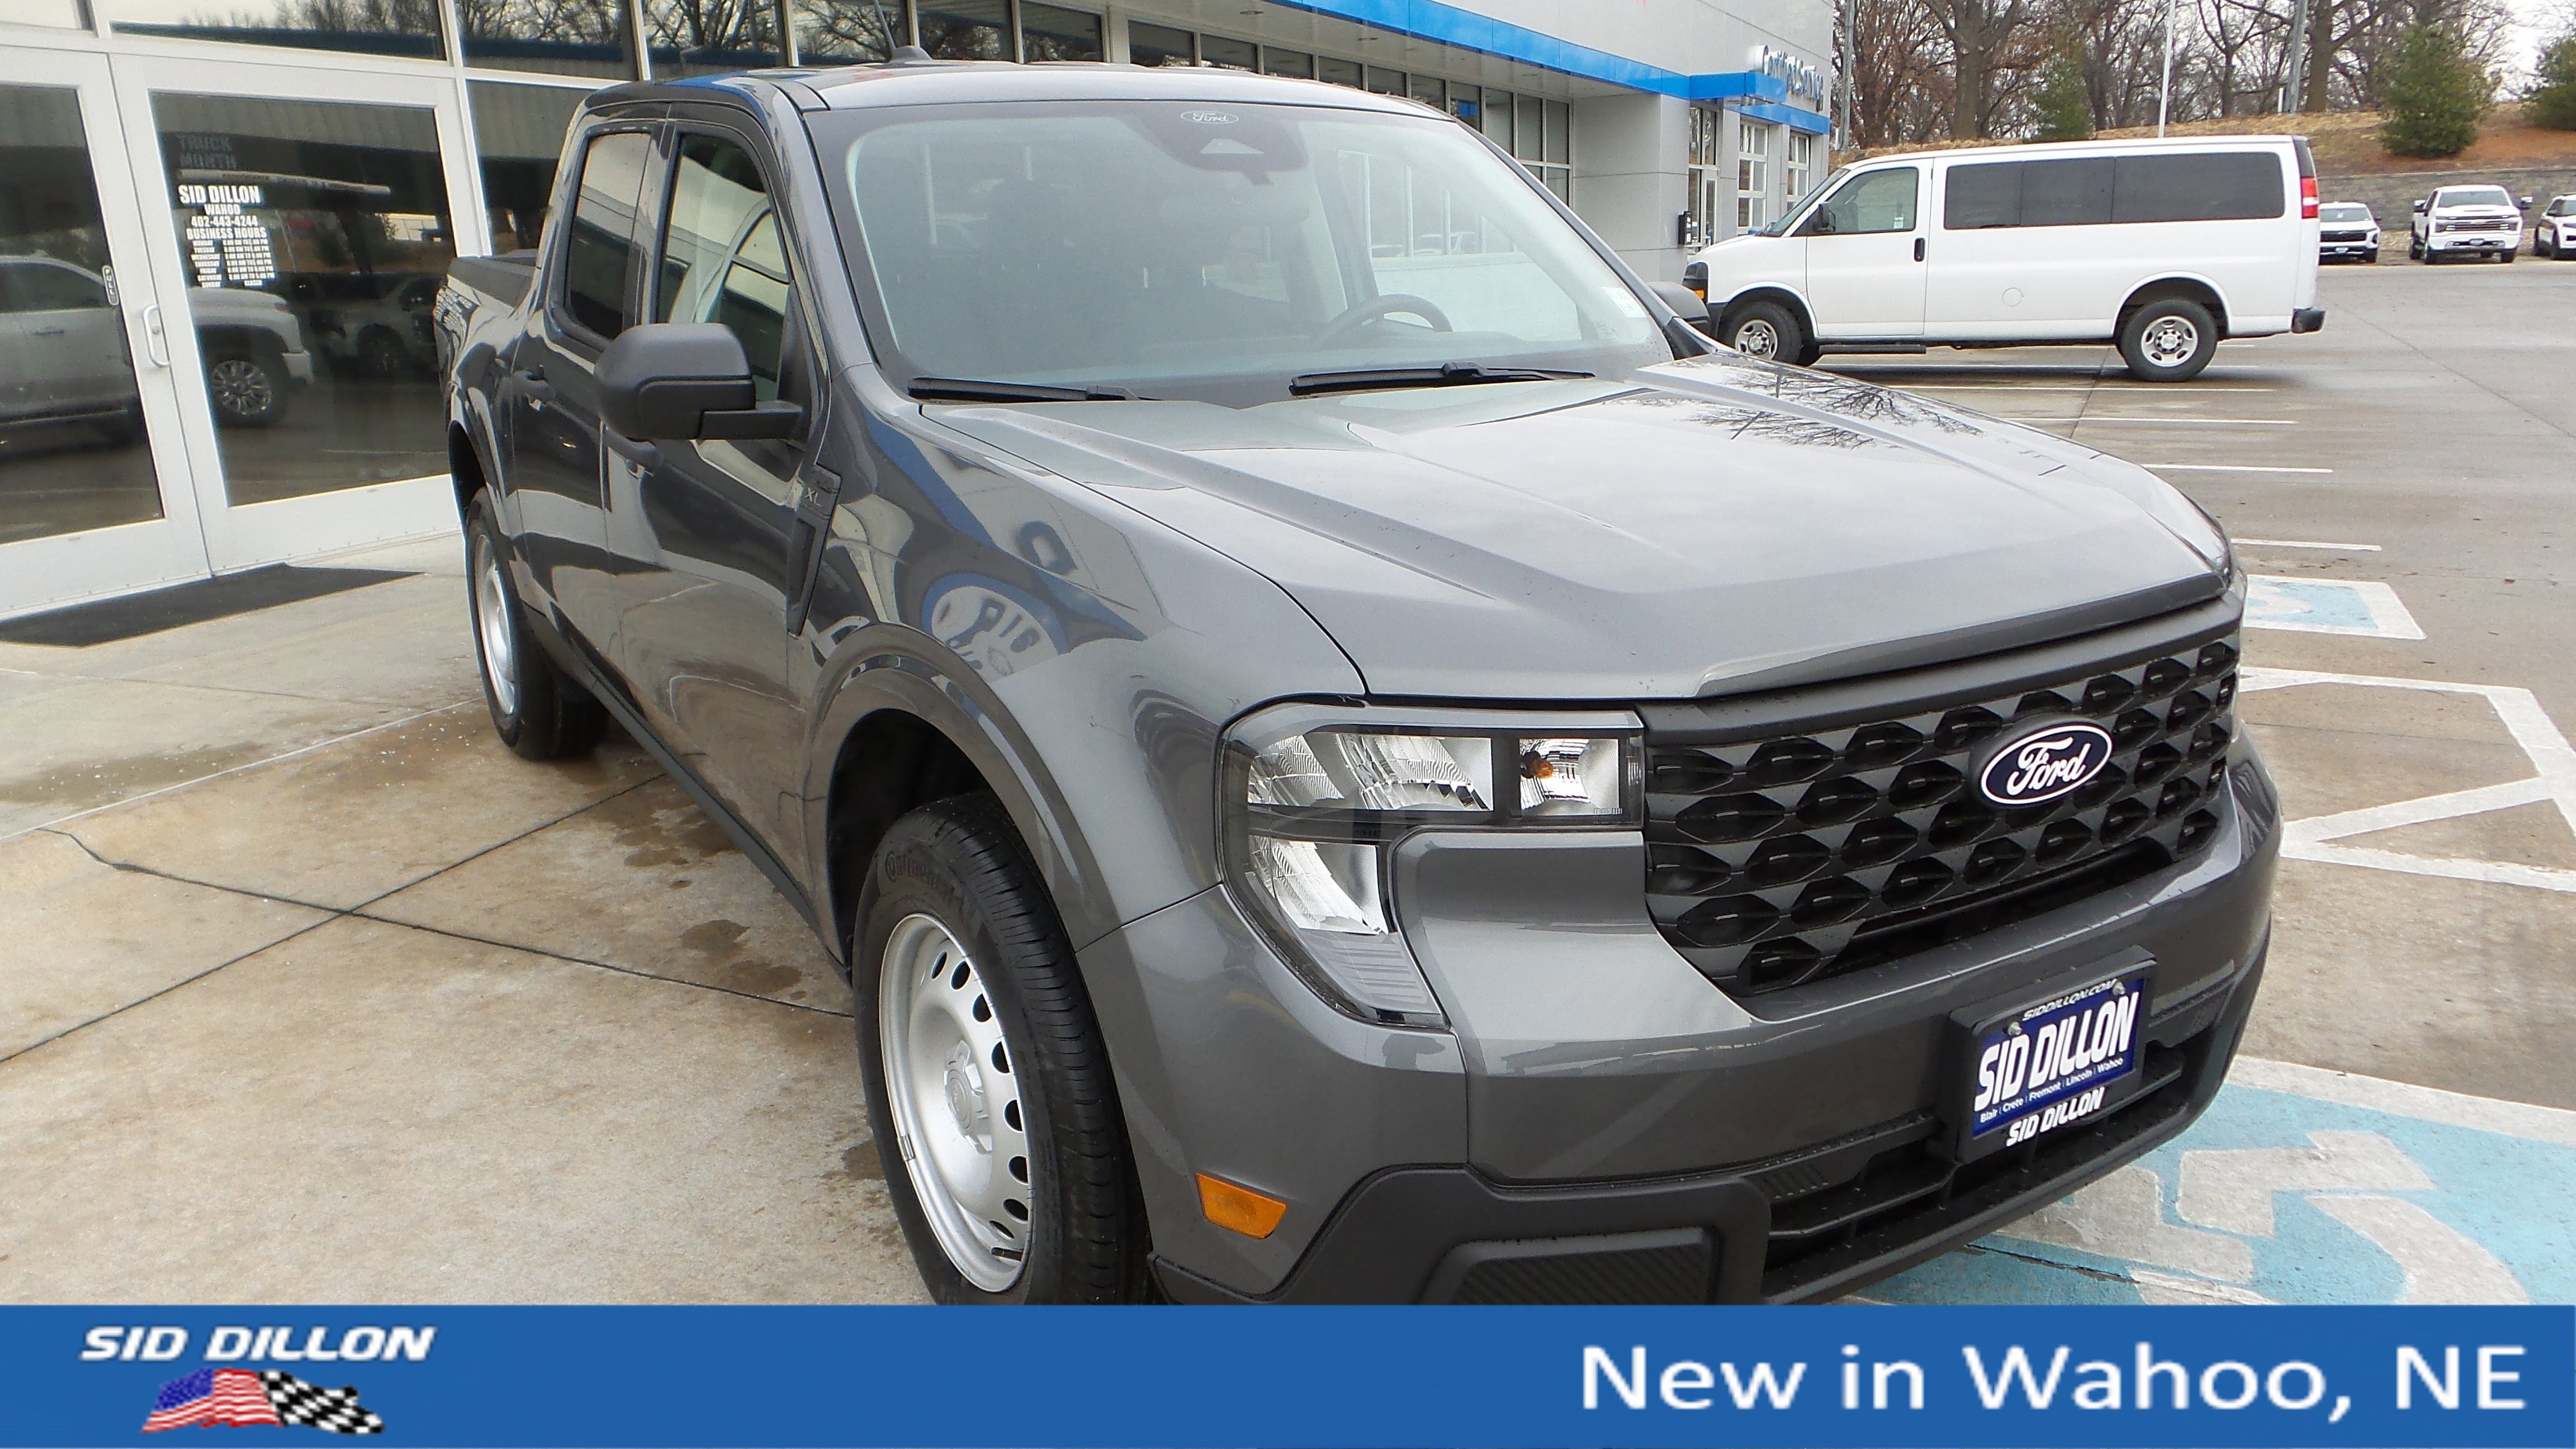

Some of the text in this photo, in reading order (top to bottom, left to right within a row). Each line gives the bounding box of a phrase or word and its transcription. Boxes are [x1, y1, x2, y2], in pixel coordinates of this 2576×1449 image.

[1192, 112, 1229, 121] Ford
[178, 185, 261, 203] SID DILLON
[203, 204, 241, 215] WAHOO
[191, 216, 258, 228] 402-443-4244
[186, 227, 267, 240] BUSINESS HOURS
[105, 268, 115, 295] PULL
[804, 487, 822, 507] XL
[2007, 737, 2092, 795] Ford
[1974, 992, 2139, 1111] SID DILLON
[1980, 1109, 1997, 1123] Blair
[2002, 1097, 2024, 1112] Crete
[2029, 1081, 2061, 1101] Fremont
[2097, 1057, 2124, 1073] Wahoo
[2006, 1087, 2105, 1147] SID DILLON
